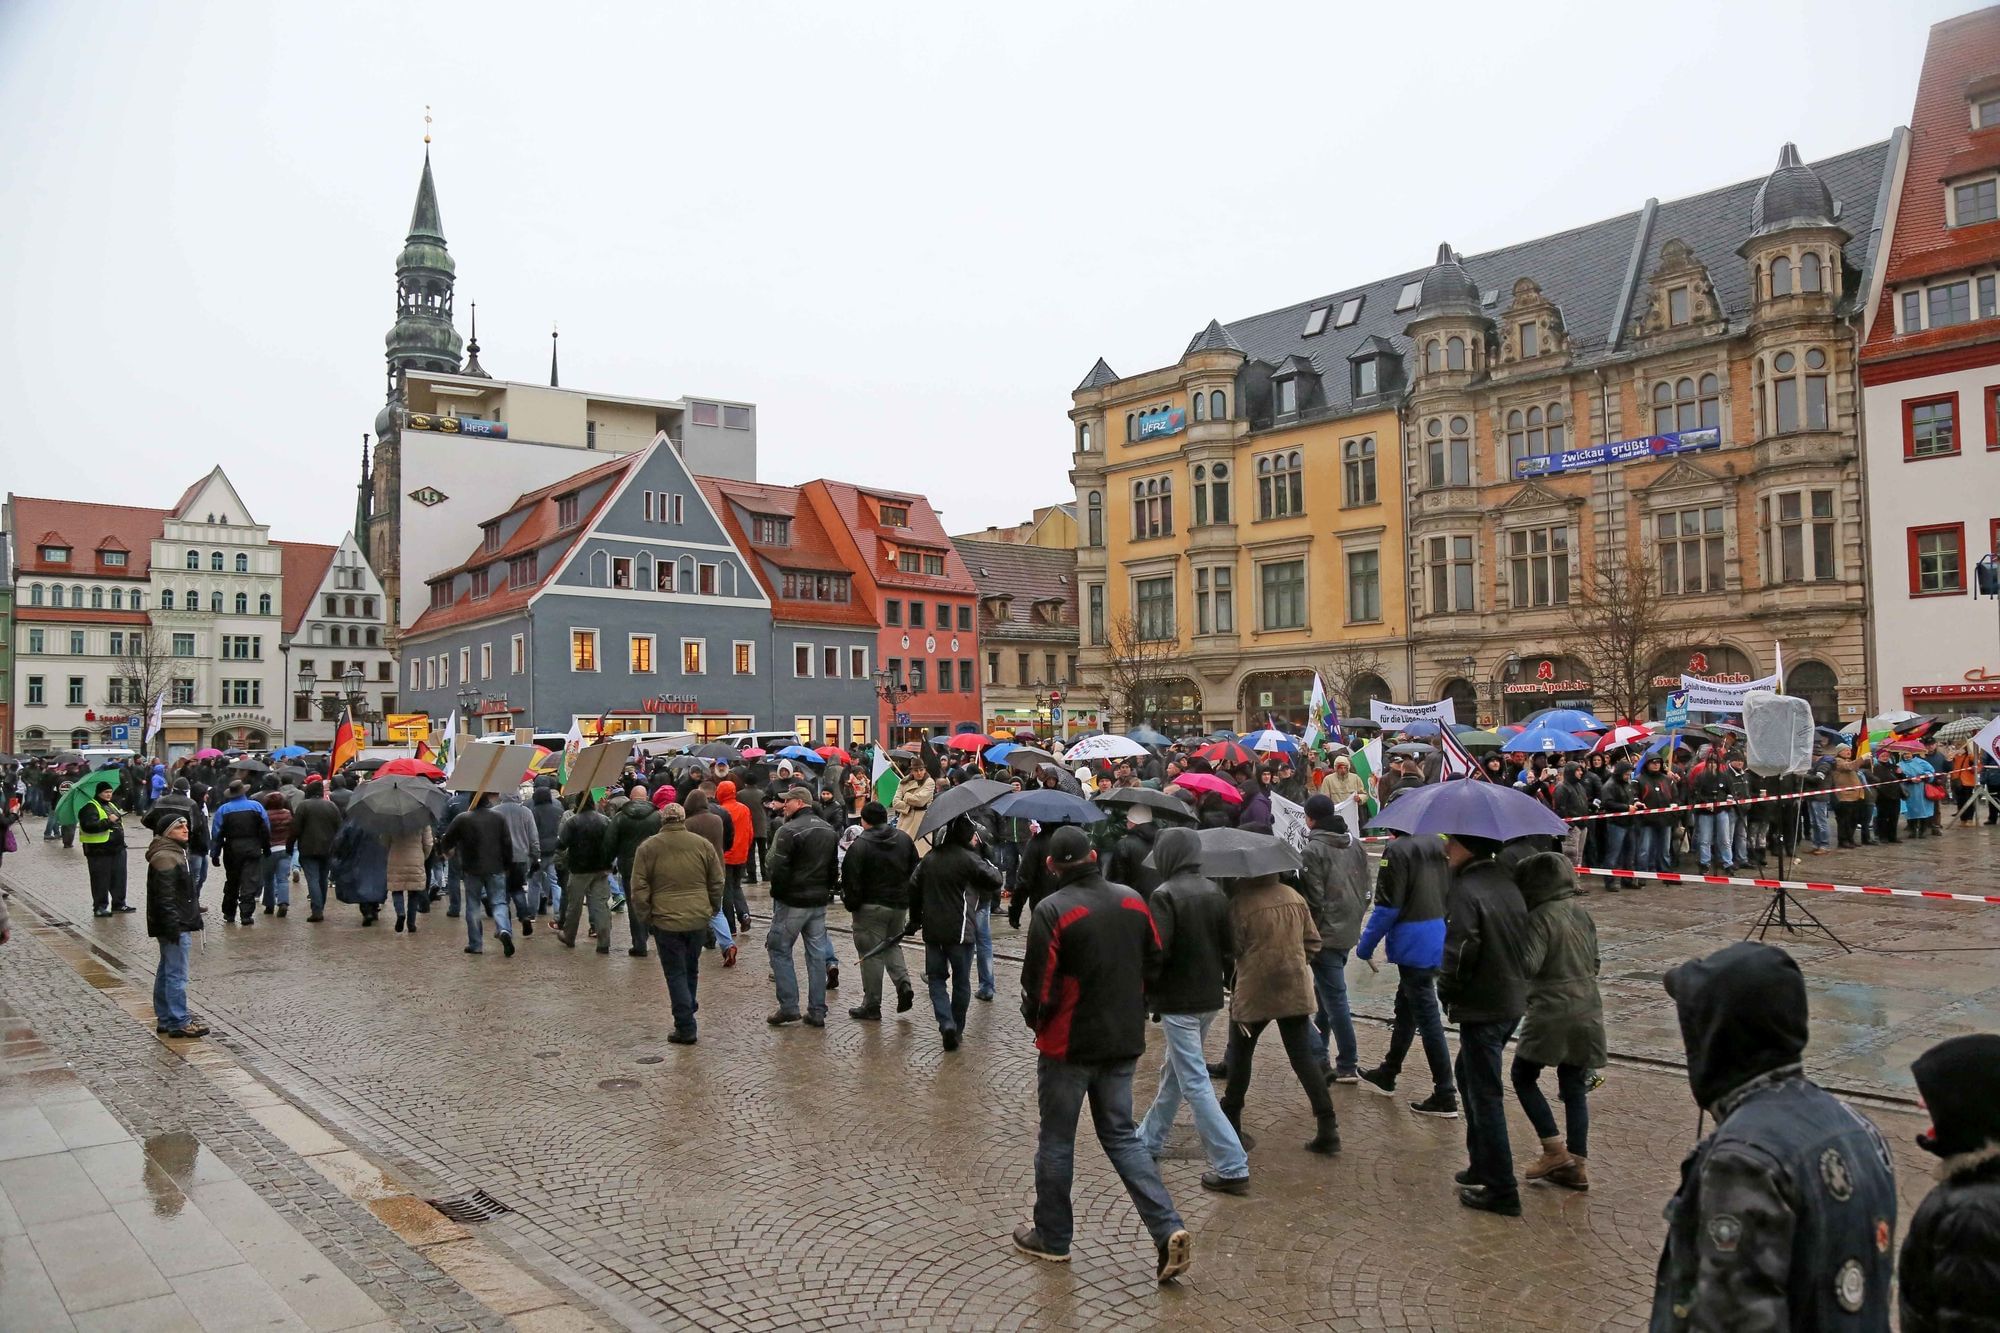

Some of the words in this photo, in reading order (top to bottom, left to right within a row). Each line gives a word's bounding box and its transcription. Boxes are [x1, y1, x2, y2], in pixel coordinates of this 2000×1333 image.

[1141, 421, 1166, 434] HERZ
[1561, 448, 1604, 463] Zwickau
[1611, 438, 1650, 456] grüßt!
[1910, 686, 1942, 694] CAFÉ
[1961, 685, 1986, 693] BAR
[1391, 715, 1401, 723] die
[115, 727, 125, 739] P
